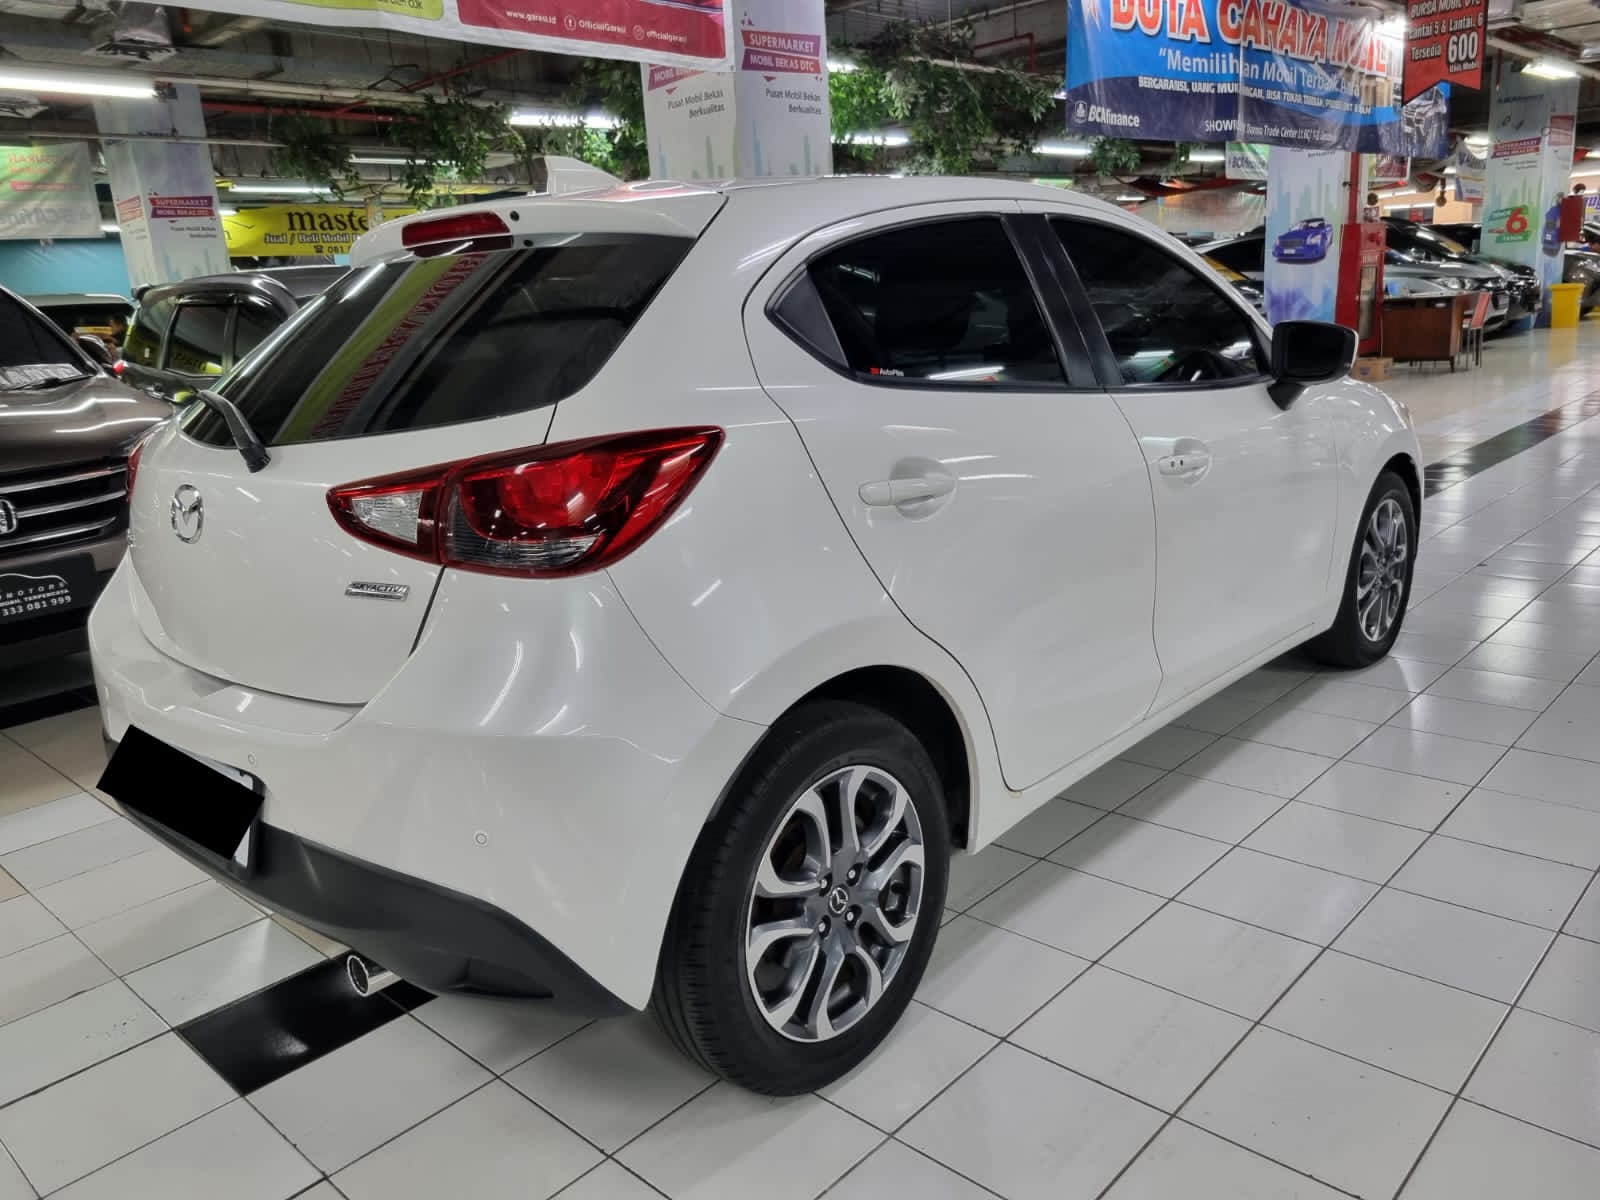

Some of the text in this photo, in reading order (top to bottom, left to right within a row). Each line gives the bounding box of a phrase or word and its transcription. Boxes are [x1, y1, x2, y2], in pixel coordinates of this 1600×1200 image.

[1477, 12, 1484, 27] 6
[1217, 0, 1328, 63] CAHAYA
[749, 33, 815, 53] SUPERMARKET
[1411, 31, 1479, 63] Tersedia 600
[750, 53, 815, 71] MOBIL BEKAS DTC
[1263, 61, 1297, 85] Mobil
[1191, 82, 1216, 93] UANG
[1088, 104, 1140, 127] BCAfinance
[1264, 124, 1280, 137] Trade
[288, 209, 369, 232] maste
[1505, 207, 1528, 234] 6
[264, 232, 288, 244] Jual
[300, 232, 320, 244] Beli
[322, 232, 349, 244] Mobil
[2, 605, 24, 616] 333
[51, 595, 72, 605] 999
